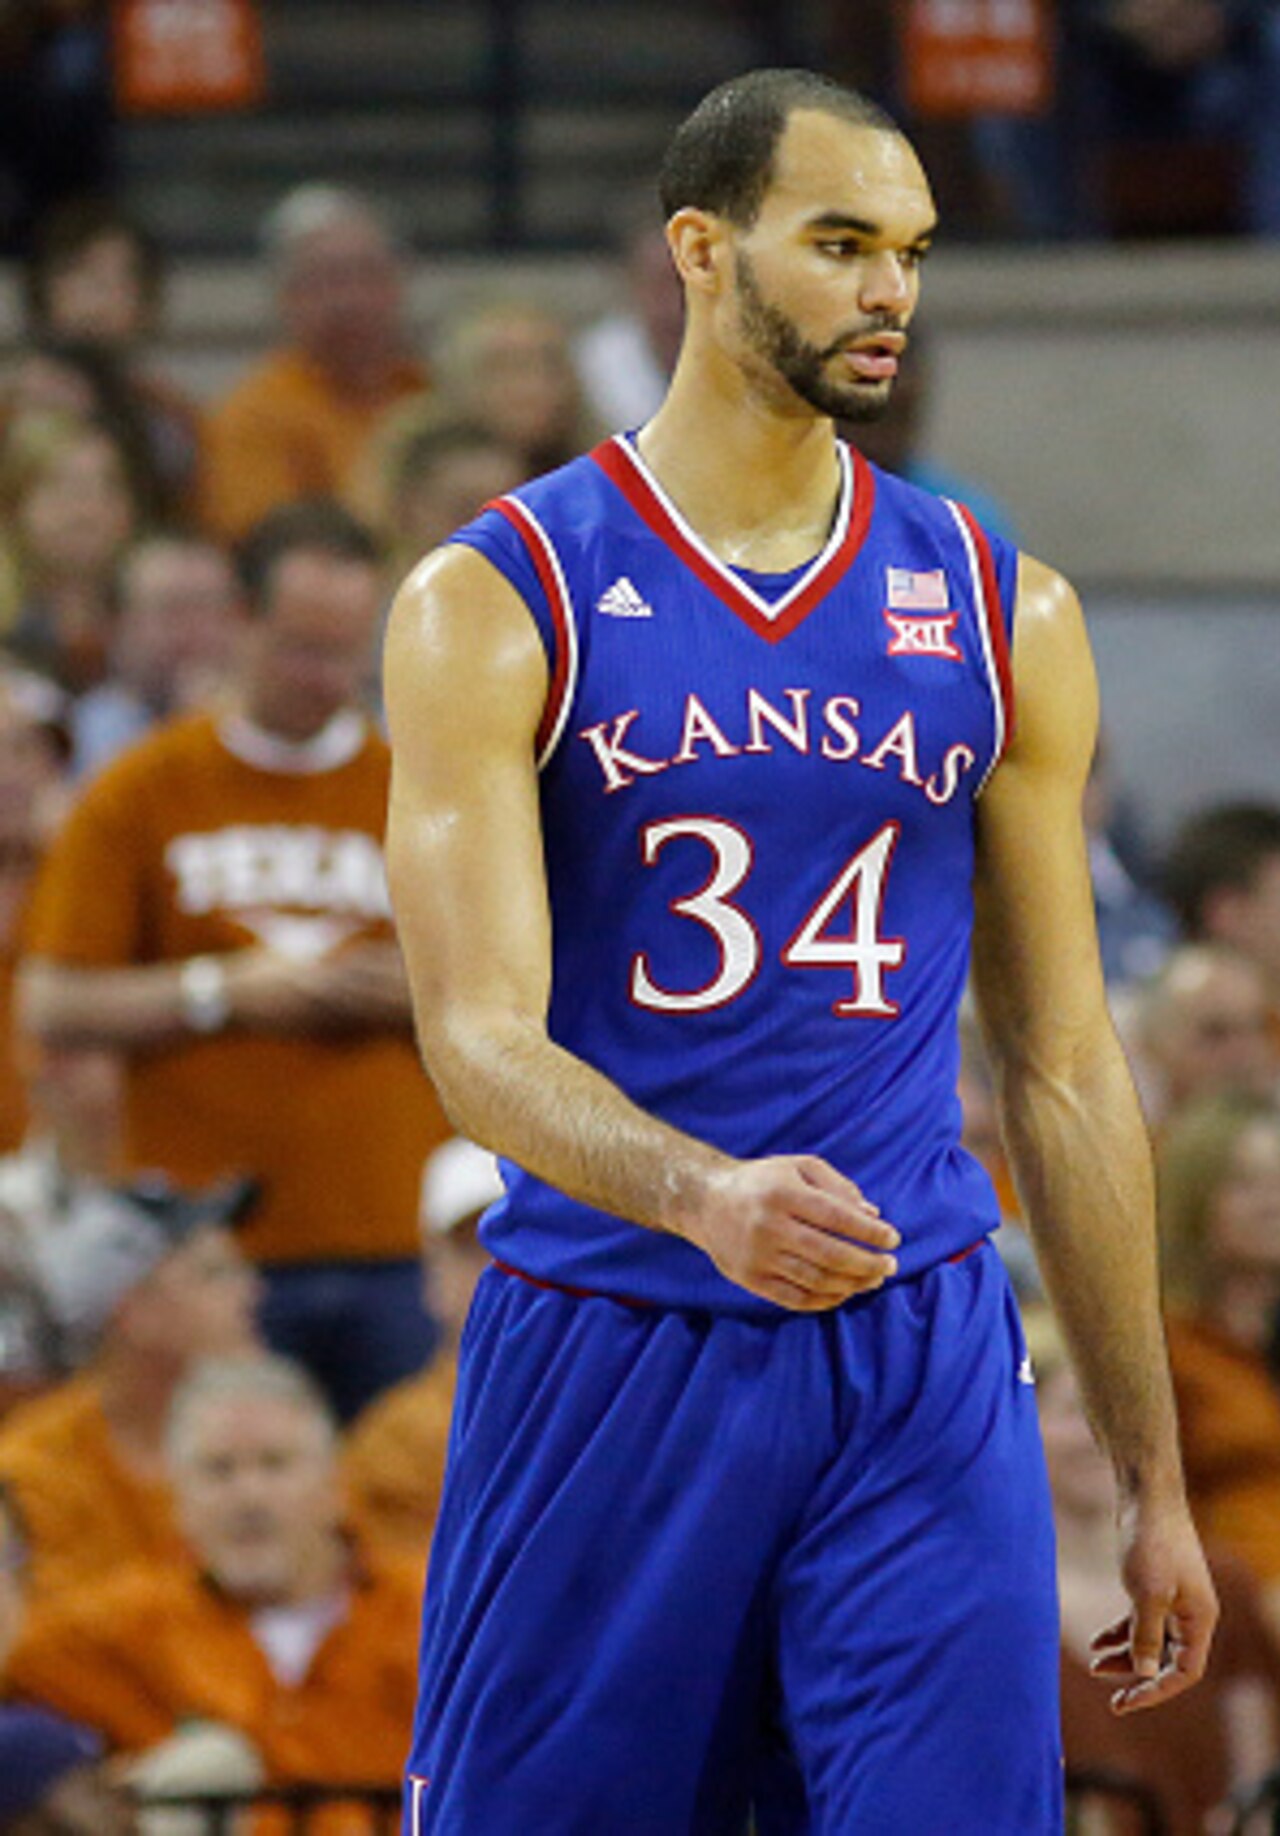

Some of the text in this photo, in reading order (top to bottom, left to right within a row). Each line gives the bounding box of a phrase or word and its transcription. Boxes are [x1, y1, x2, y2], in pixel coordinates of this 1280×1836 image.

[579, 688, 977, 805] KANSAS
[163, 824, 393, 916] TEXA
[628, 812, 907, 1019] 34
